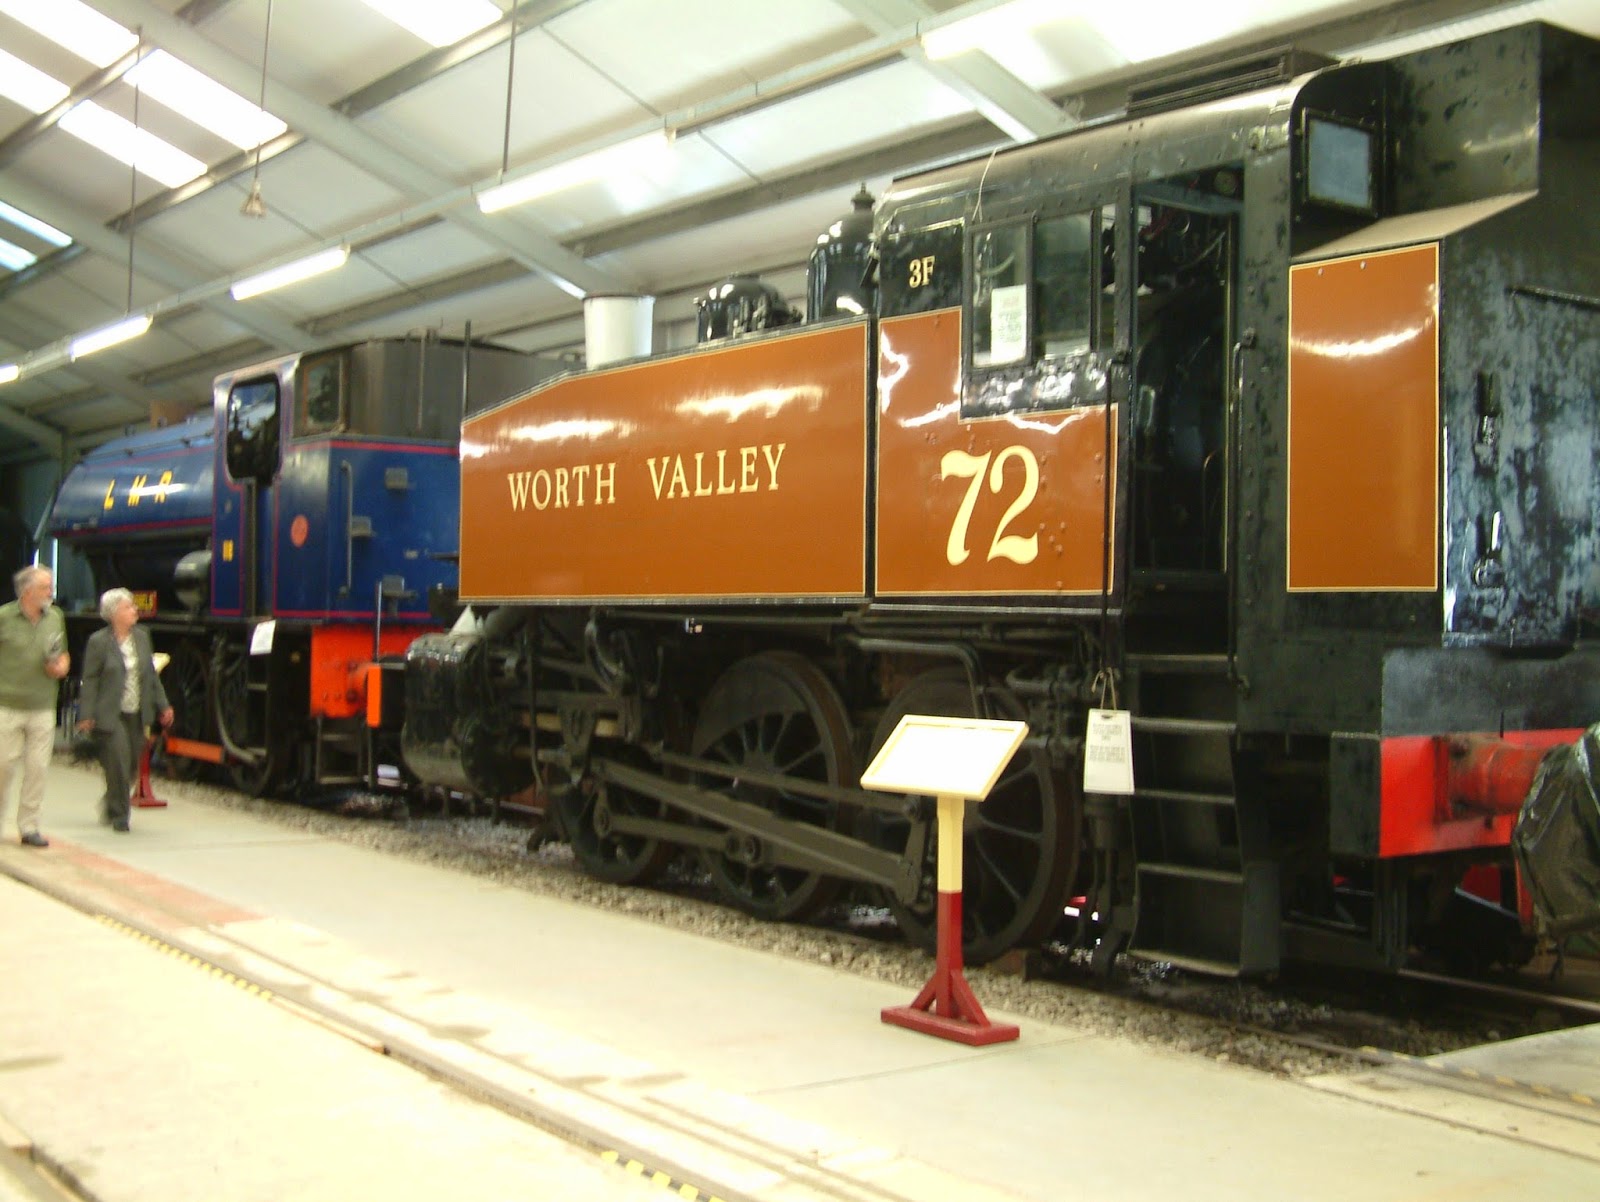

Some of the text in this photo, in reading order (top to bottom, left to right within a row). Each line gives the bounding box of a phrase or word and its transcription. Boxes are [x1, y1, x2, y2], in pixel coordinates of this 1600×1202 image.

[909, 256, 936, 288] 3F
[507, 442, 787, 512] WORTH VALLEY
[940, 445, 1040, 567] 72
